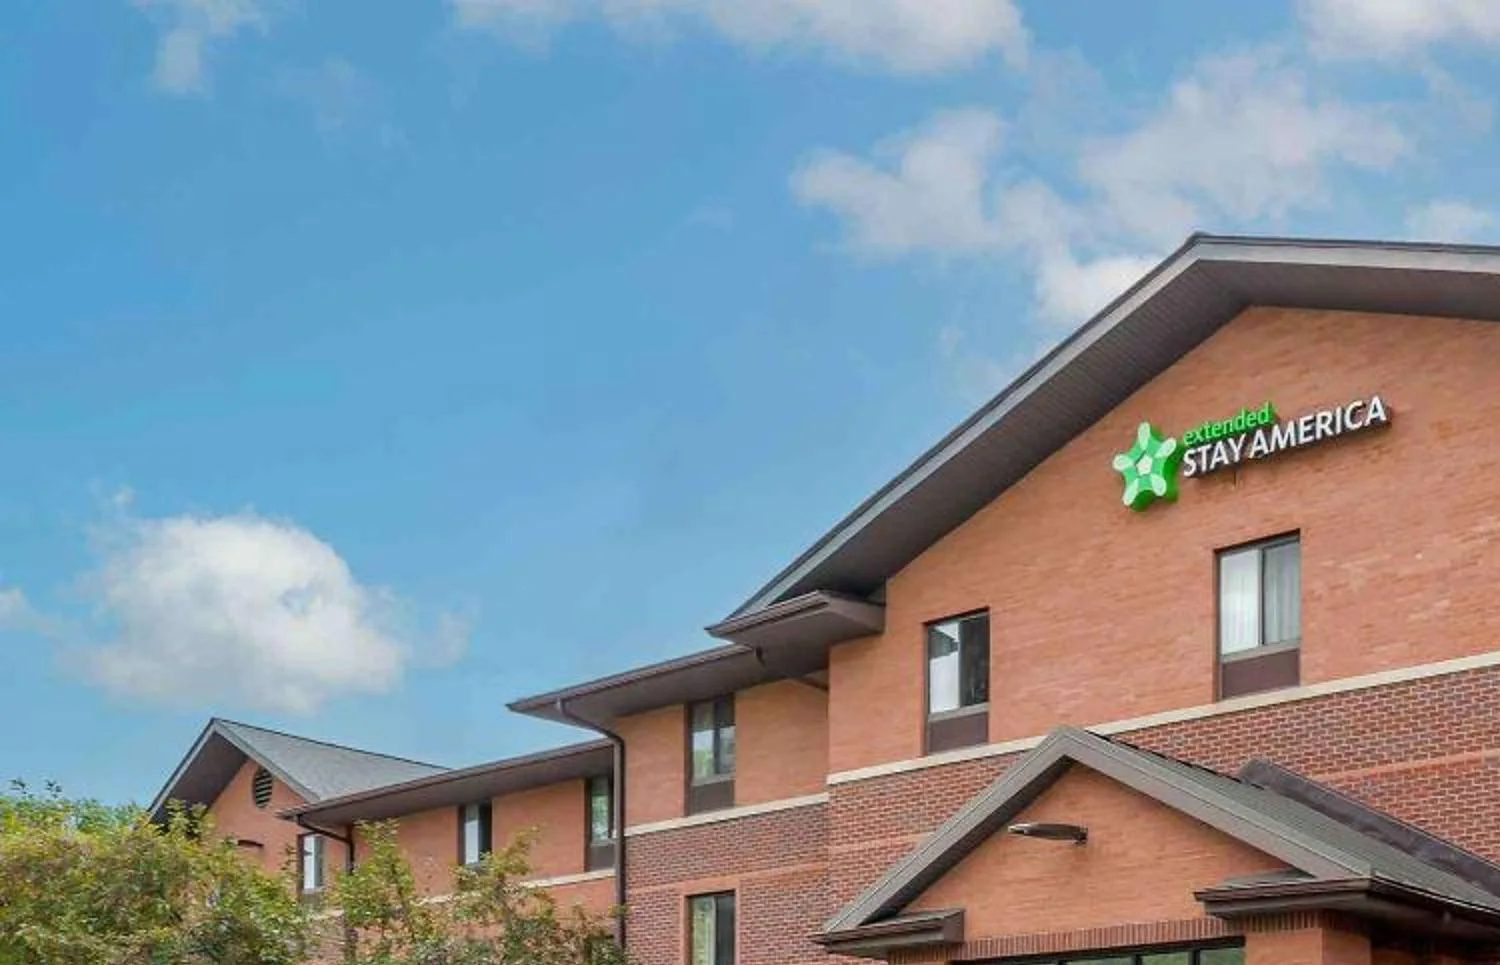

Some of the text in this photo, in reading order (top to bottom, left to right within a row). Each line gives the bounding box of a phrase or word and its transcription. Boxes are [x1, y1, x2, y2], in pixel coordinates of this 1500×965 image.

[1182, 401, 1274, 446] extended
[1182, 395, 1388, 477] STAY AMERICA
